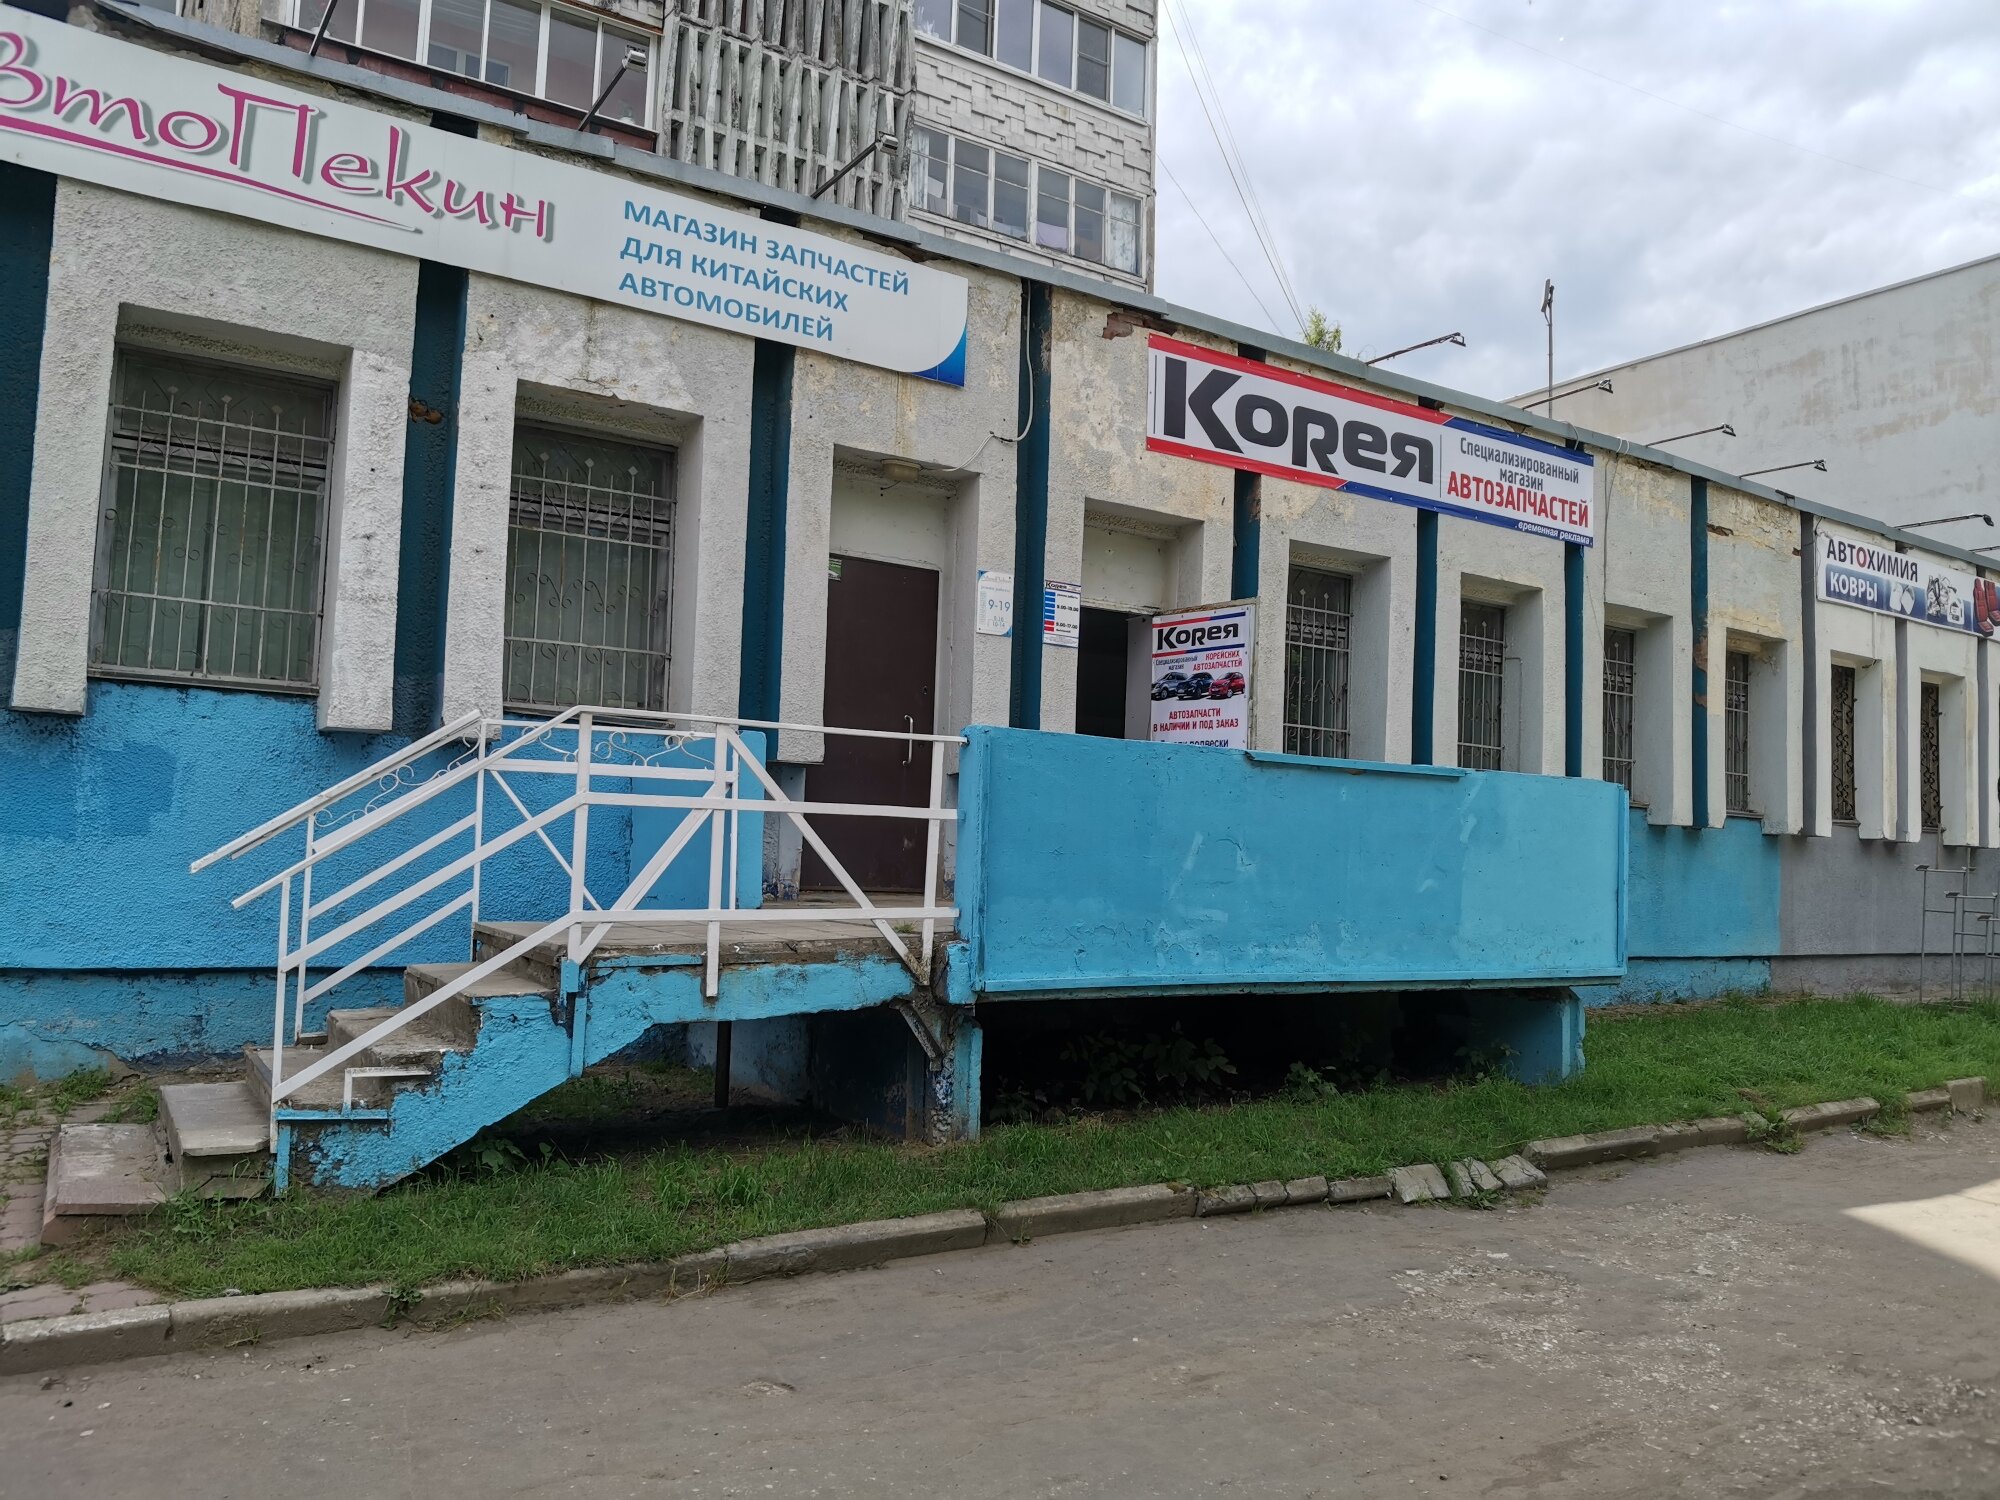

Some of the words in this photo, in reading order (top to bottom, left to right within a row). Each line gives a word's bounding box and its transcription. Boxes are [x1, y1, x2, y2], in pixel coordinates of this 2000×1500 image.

[623, 200, 757, 254] МАГАЗИН
[765, 239, 909, 296] ЗАПЧАСТЕЙ
[619, 236, 682, 270] ДЛЯ
[691, 253, 849, 312] КИТАЙСКИХ
[618, 272, 834, 342] АВТОМОБИЛЕЙ
[1460, 436, 1580, 485] Специализированный
[1499, 466, 1544, 492] магазин
[1446, 470, 1589, 529] АВТОЗАПЧАСТЕЙ
[1518, 521, 1559, 538] временная
[1559, 531, 1590, 545] реклама
[1826, 538, 1919, 583] АВТОХИМИЯ
[1830, 571, 1878, 602] КОВРЫ
[989, 599, 1011, 612] 9-19
[1192, 657, 1243, 672] АВТОЗАПЧАСТЕЙ
[1153, 724, 1158, 733] В
[1159, 720, 1191, 732] НАЛИЧИИ
[1192, 720, 1197, 730] И
[1199, 719, 1214, 731] ПОД
[1216, 718, 1239, 729] ЗАКАЗ
[1168, 707, 1221, 721] АВТОЗАПЧАСТИ
